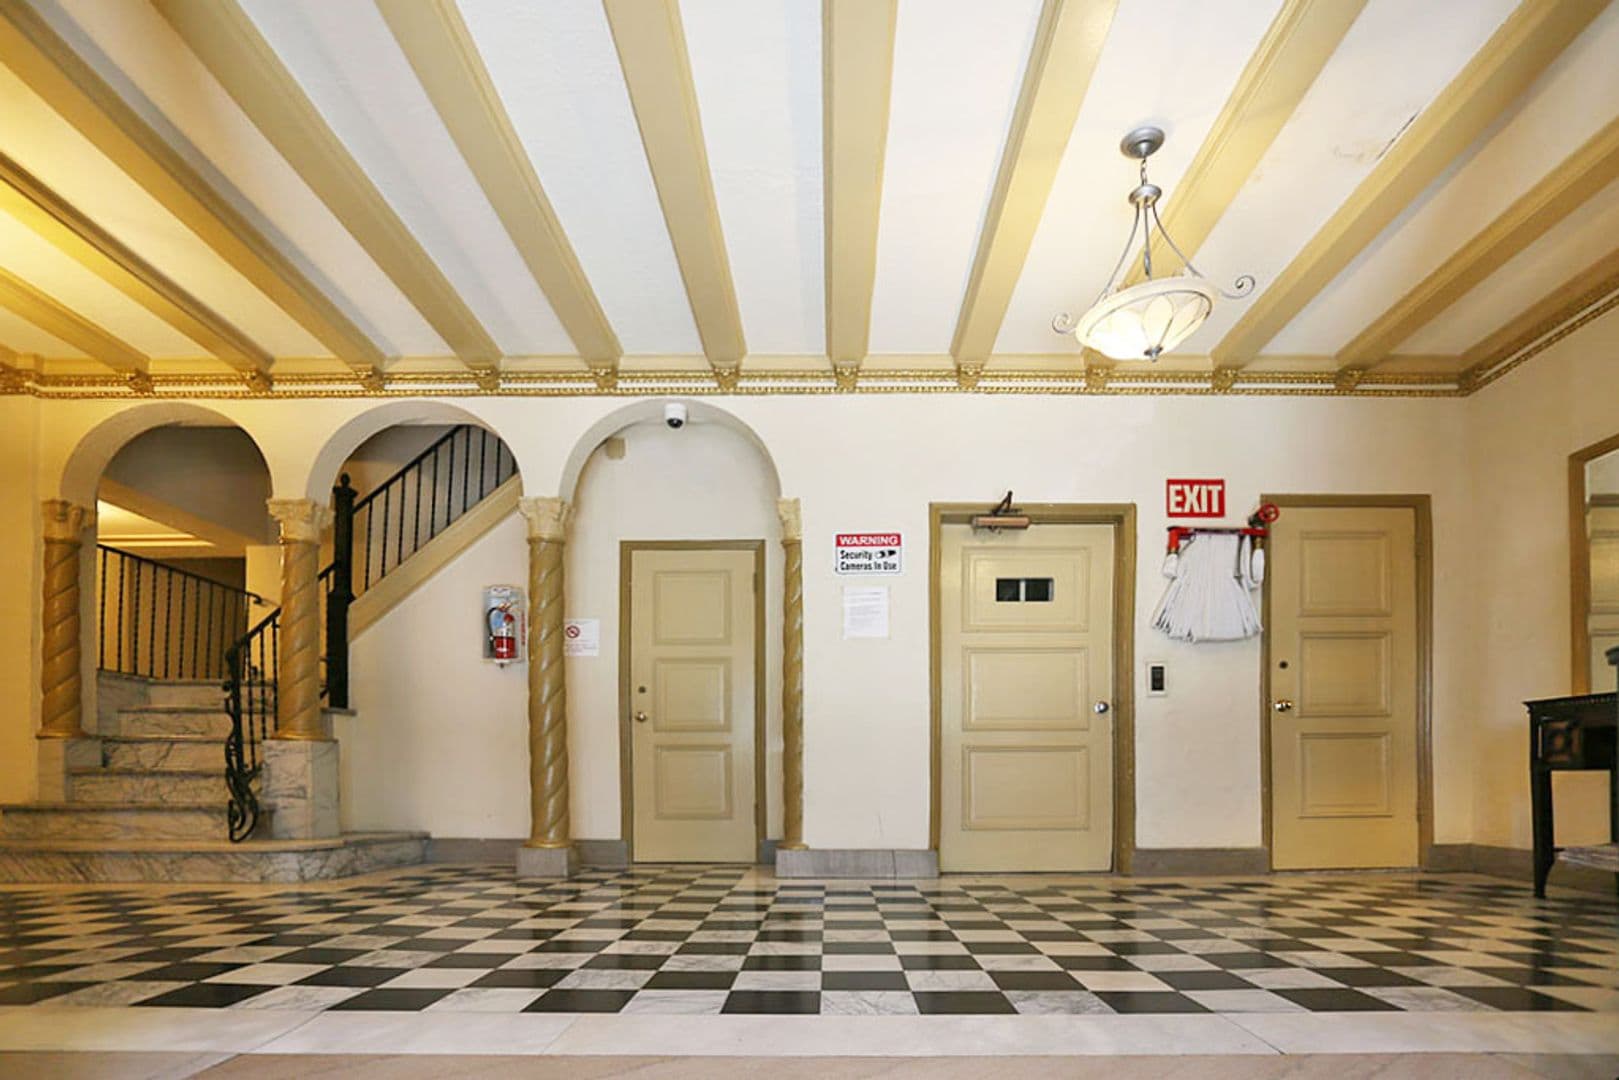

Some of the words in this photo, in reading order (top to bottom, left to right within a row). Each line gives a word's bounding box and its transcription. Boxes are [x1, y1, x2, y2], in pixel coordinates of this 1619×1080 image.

[1169, 485, 1222, 513] EXIT
[839, 536, 898, 545] WARNING
[840, 550, 873, 560] Security
[840, 561, 872, 570] Cameras
[874, 561, 882, 570] In
[883, 561, 897, 570] Use
